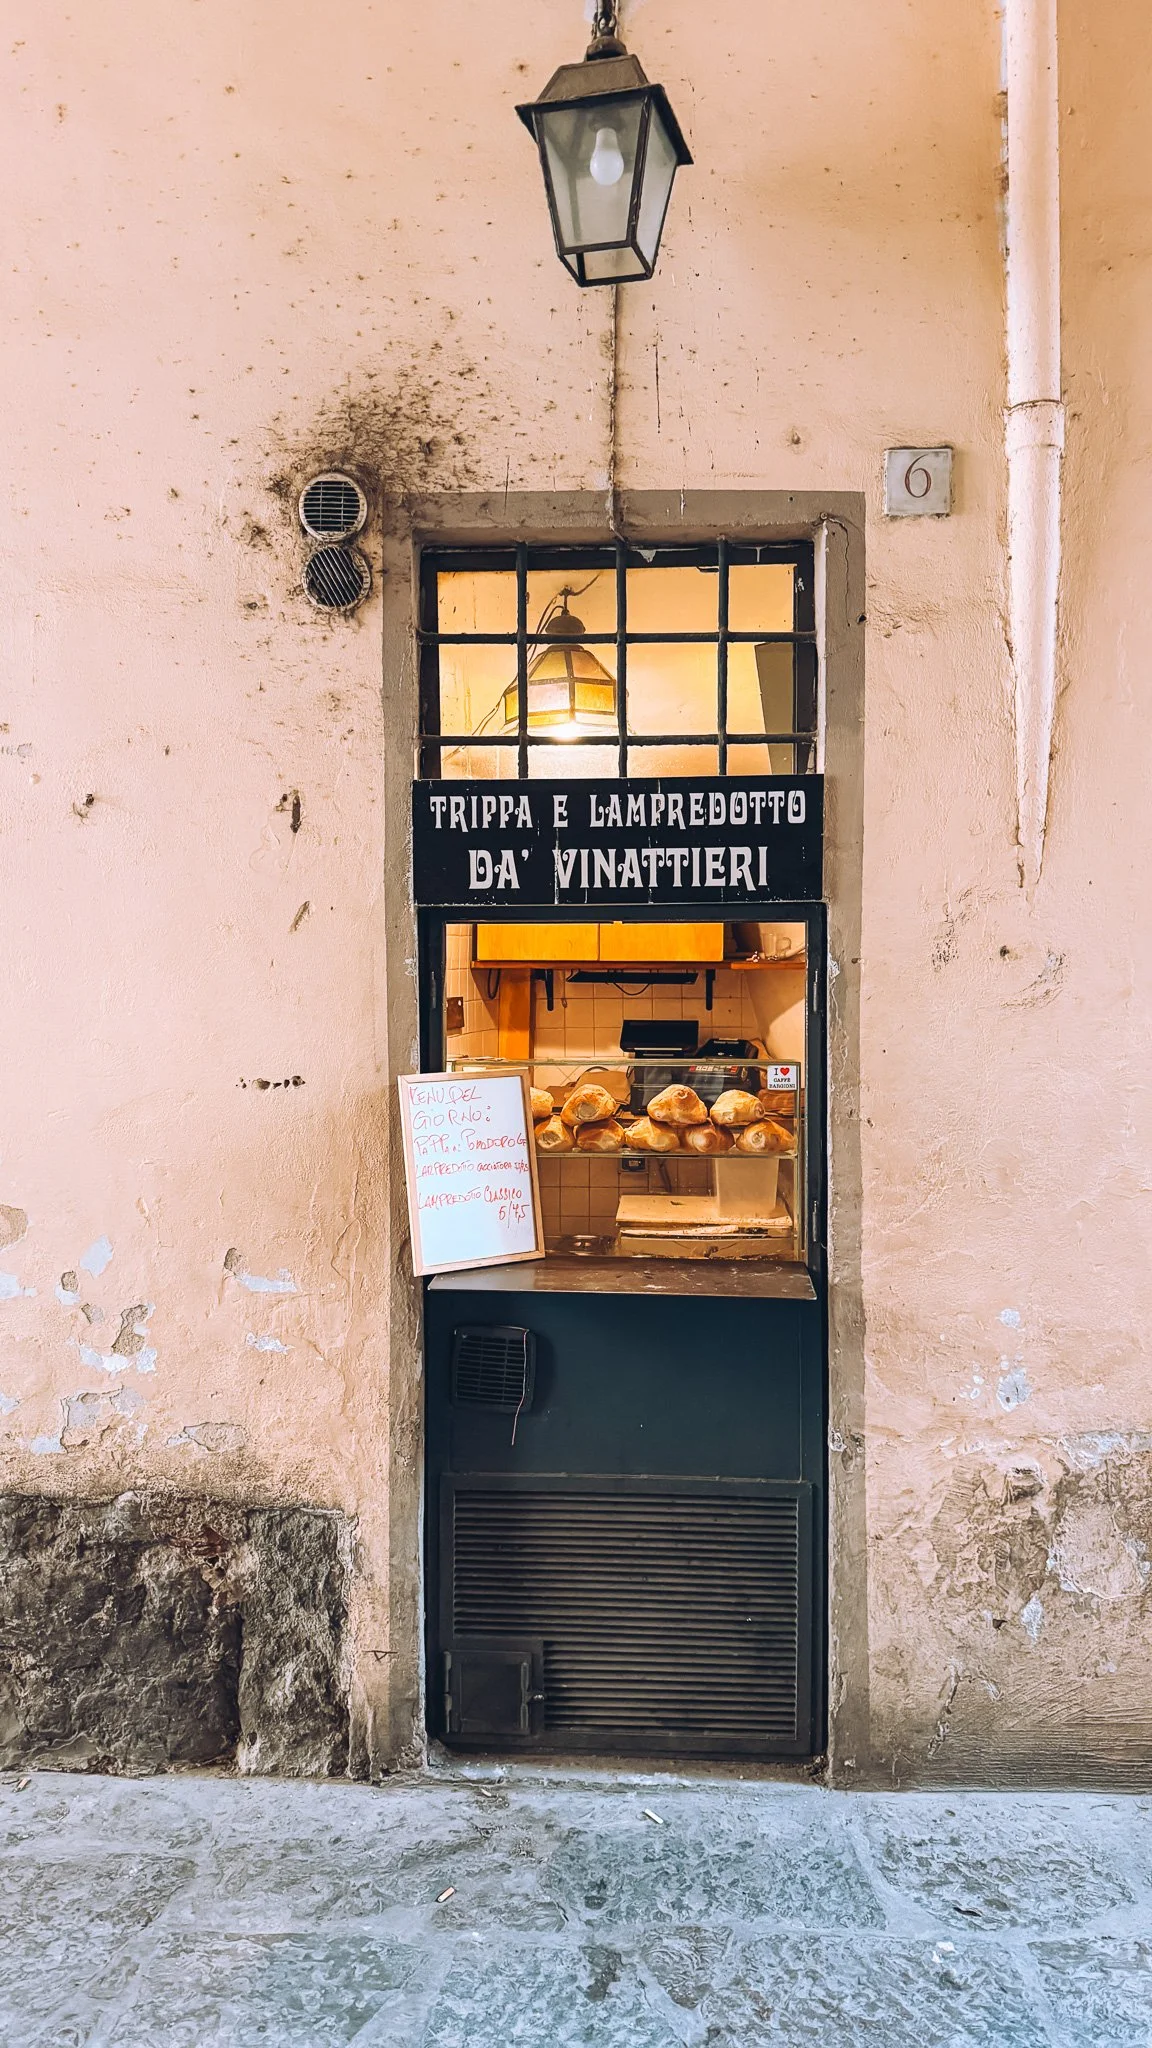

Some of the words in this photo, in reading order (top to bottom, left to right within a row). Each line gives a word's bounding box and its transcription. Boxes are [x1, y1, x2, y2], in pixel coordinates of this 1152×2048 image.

[904, 453, 932, 498] 6
[429, 795, 534, 833] TRIPPA
[552, 794, 568, 828] E
[589, 790, 807, 830] LAMPREDOTTO
[468, 848, 530, 890] DA'
[553, 846, 769, 891] VINATTIERI
[445, 1086, 482, 1104] DEL
